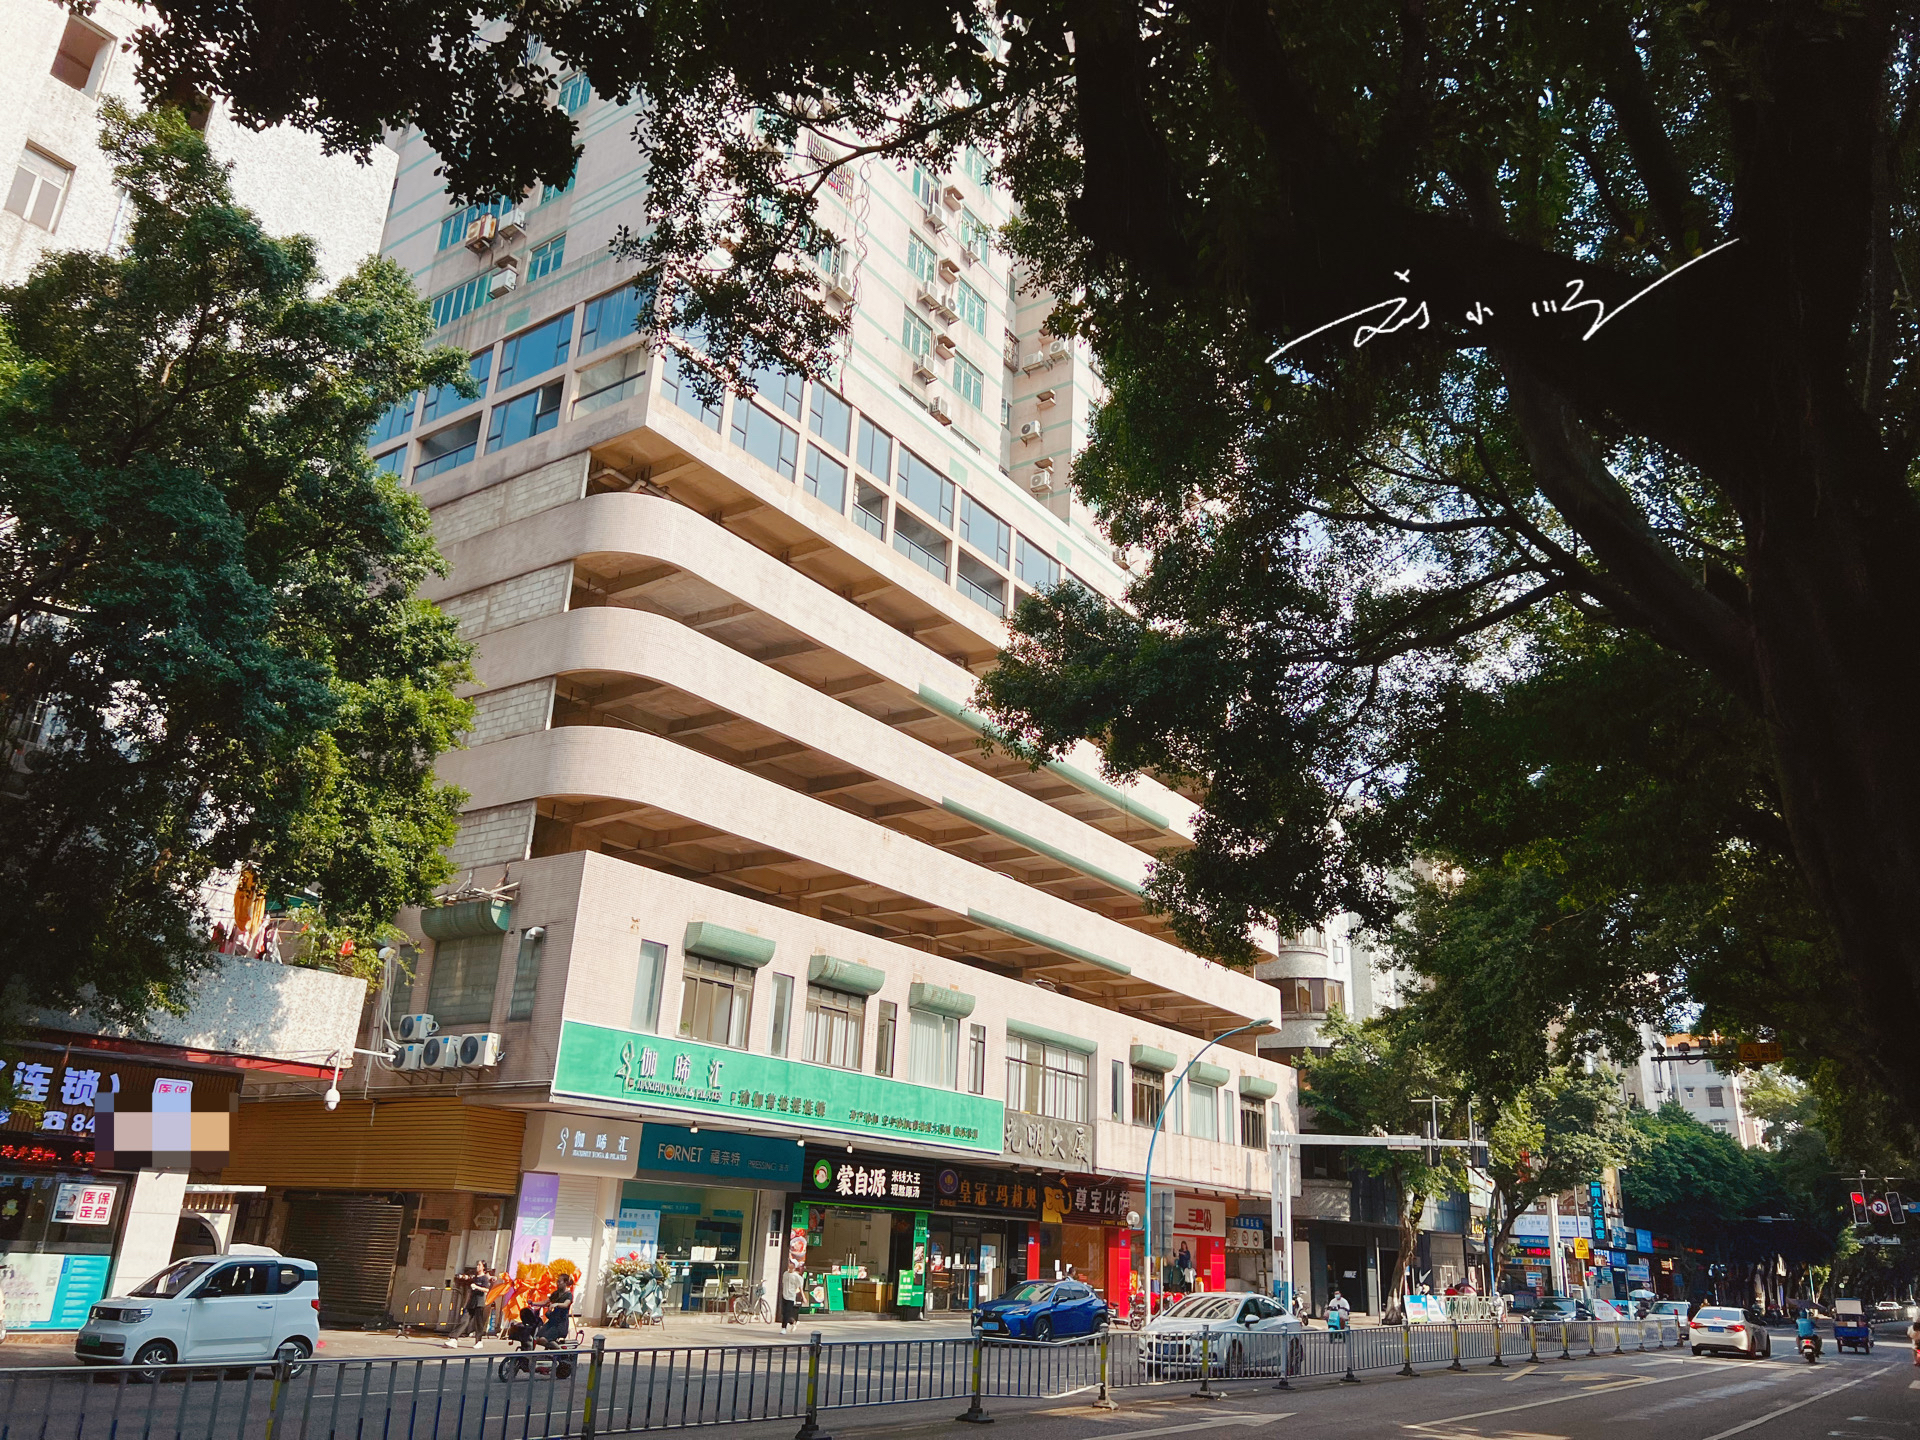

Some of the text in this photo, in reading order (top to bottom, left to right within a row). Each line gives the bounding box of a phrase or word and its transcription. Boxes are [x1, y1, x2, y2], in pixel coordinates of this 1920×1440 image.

[0, 1060, 120, 1106] 连锁）
[1005, 1118, 1088, 1163] 光明大厦
[657, 1143, 703, 1163] FORNET
[710, 1149, 740, 1166] 福奈特
[835, 1164, 887, 1198] 蒙自源
[891, 1170, 921, 1185] 米线大王
[82, 1191, 111, 1205] 医保
[1074, 1187, 1130, 1217] 尊宝比萨
[79, 1206, 107, 1219] 定点
